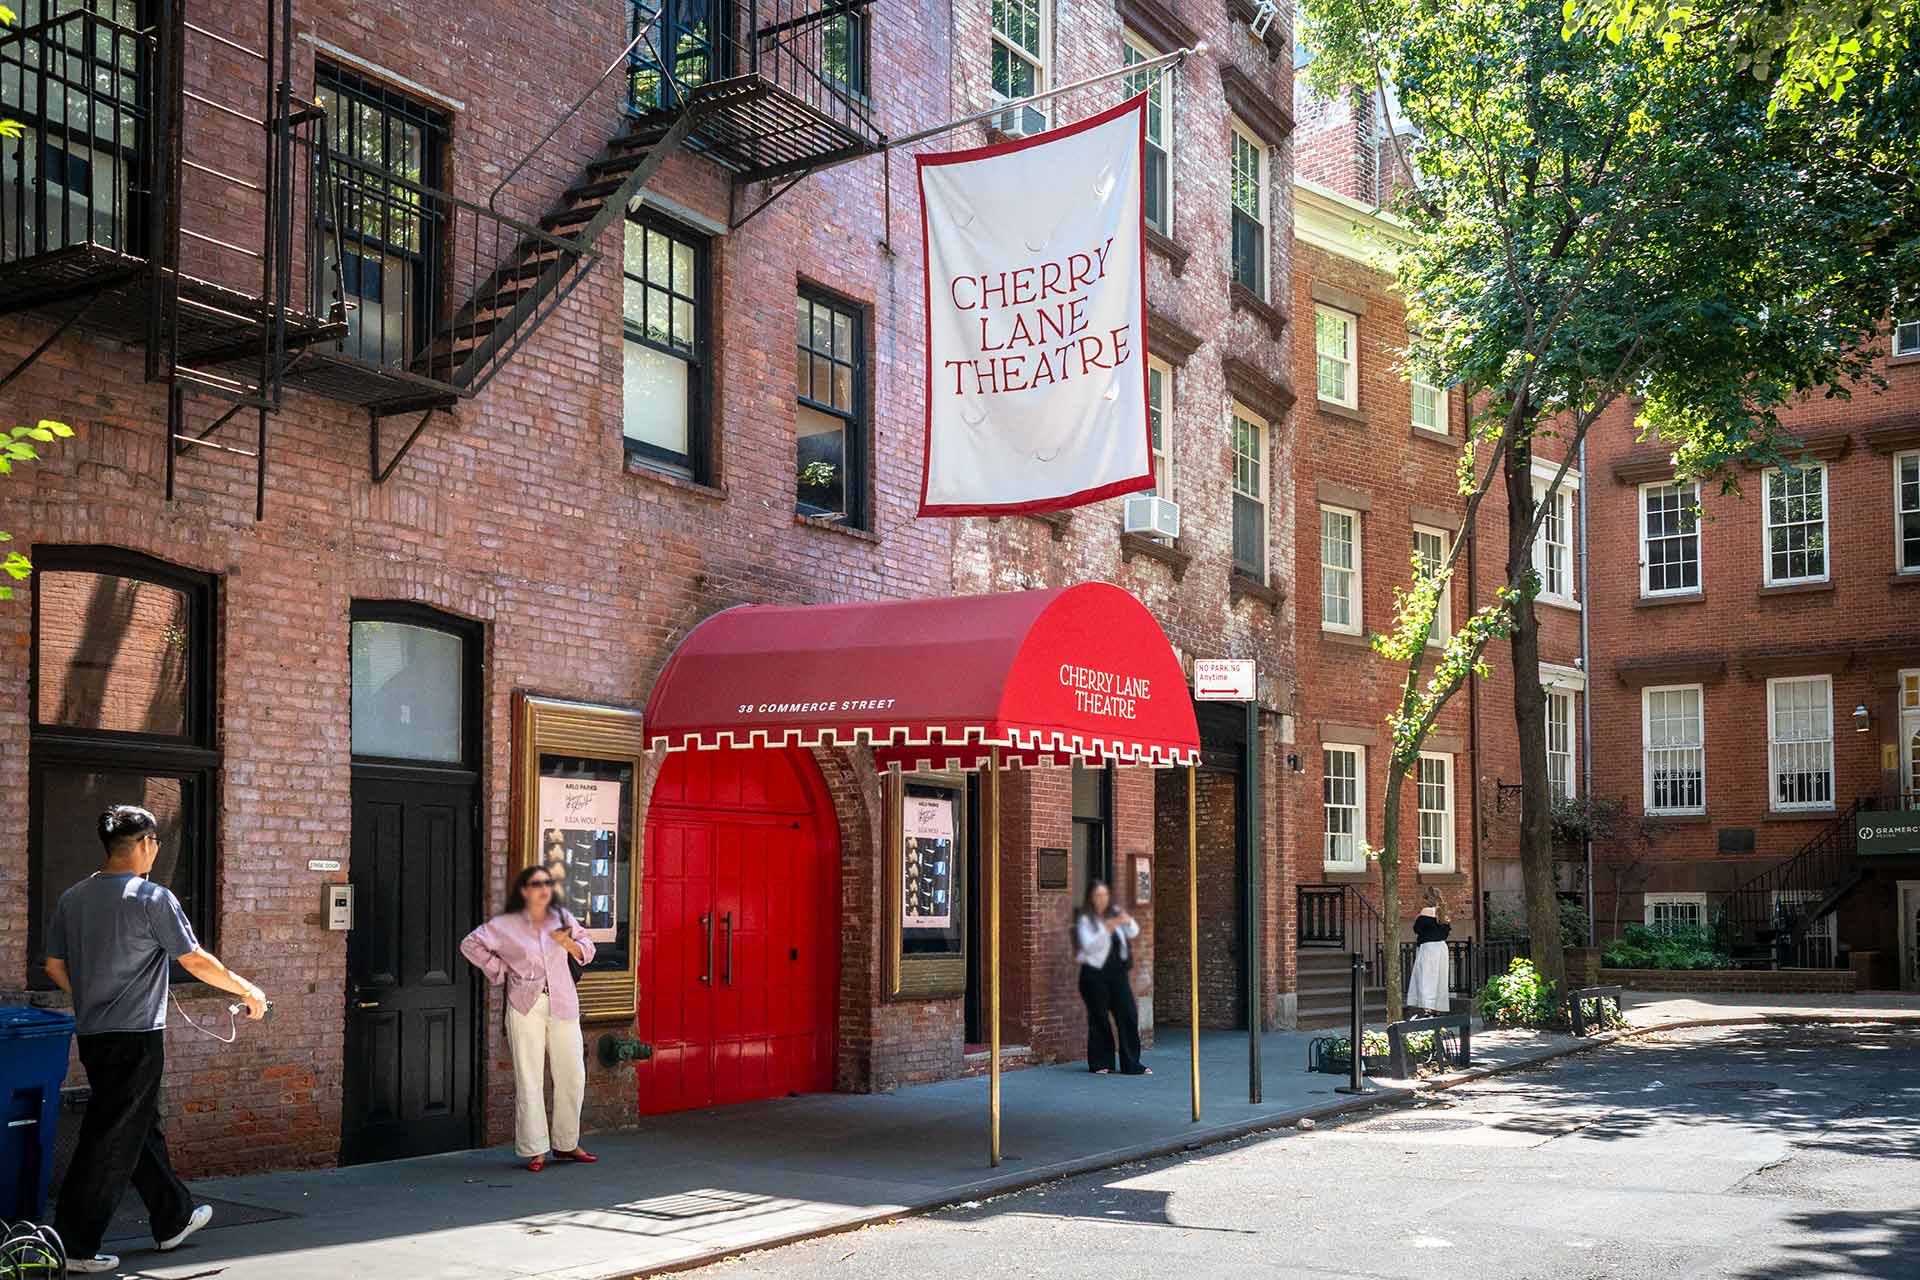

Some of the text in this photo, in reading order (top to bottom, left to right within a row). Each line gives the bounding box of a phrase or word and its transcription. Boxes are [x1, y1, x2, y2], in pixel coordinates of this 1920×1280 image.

[952, 238, 1114, 311] CHERRY
[981, 296, 1089, 352] LANE
[945, 325, 1130, 396] THEATRE
[1059, 664, 1151, 700] CHERRY LANE
[1199, 664, 1209, 672] NO
[1199, 673, 1228, 682] Anytime
[738, 699, 896, 714] 38 COMMERCE STREET
[1075, 690, 1137, 719] THEATRE
